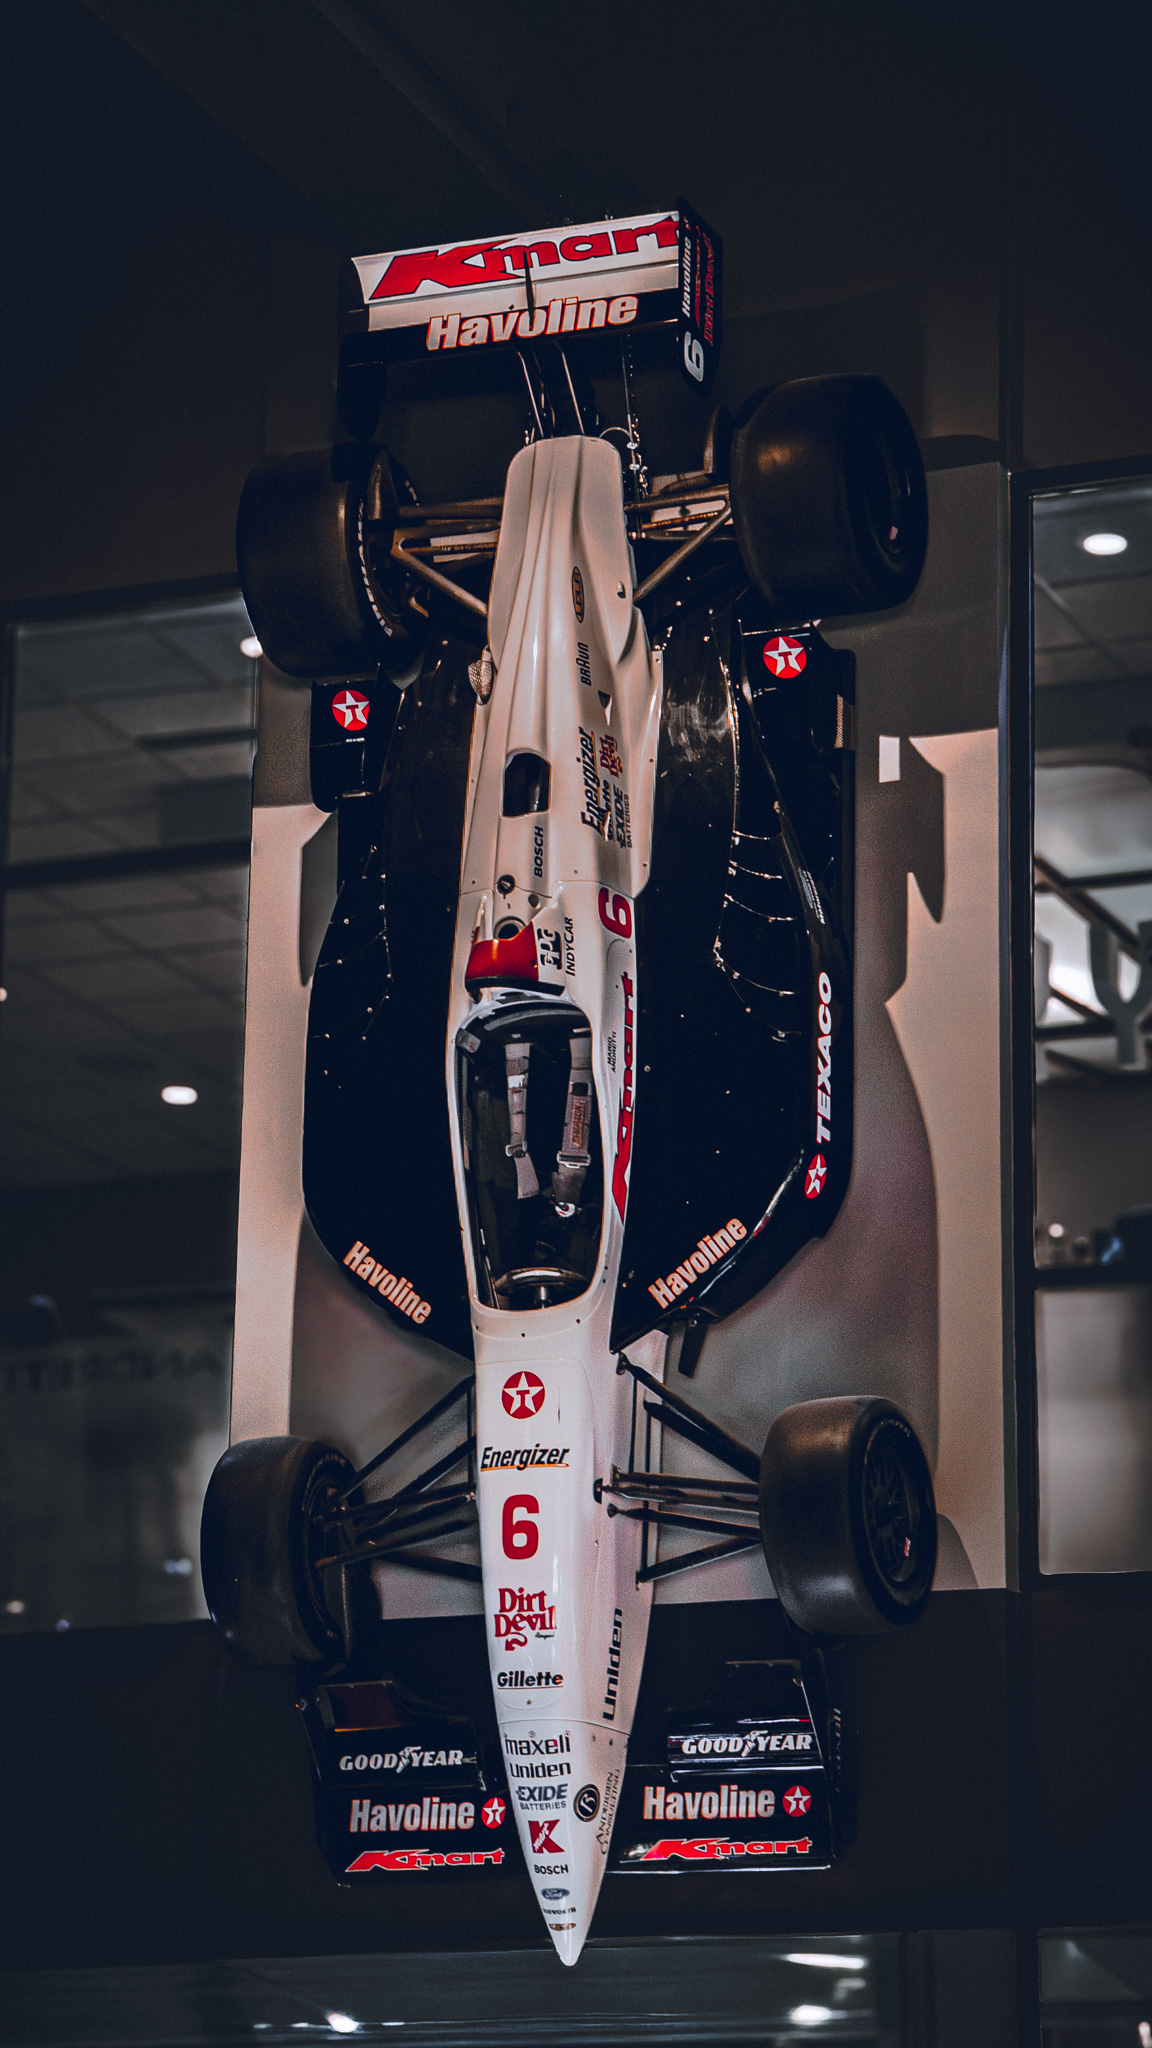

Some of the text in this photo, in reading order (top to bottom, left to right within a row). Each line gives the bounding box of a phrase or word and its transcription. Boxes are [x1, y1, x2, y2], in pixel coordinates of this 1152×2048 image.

[369, 216, 680, 300] Kmart
[682, 236, 692, 318] Havoline
[426, 294, 638, 351] Havoline
[684, 331, 704, 382] 6
[576, 642, 592, 686] BRAUN
[578, 726, 604, 834] Energizer
[612, 783, 626, 849] EXIDE
[623, 794, 633, 848] BATTERIES
[534, 826, 544, 878] BOSCH
[598, 887, 632, 939] 6
[816, 972, 832, 1144] TEXACO
[612, 972, 633, 1226] Kmart
[343, 1240, 431, 1324] Havoline
[648, 1218, 747, 1309] Havoline
[480, 1443, 570, 1472] Energizer
[502, 1494, 539, 1560] 6
[494, 1605, 557, 1637] Devil
[498, 1587, 547, 1613] Dirt
[497, 1670, 563, 1688] Gillette
[505, 1734, 571, 1756] maxell
[350, 1797, 475, 1832] Havoline
[516, 1783, 568, 1802] EXIDE
[520, 1801, 567, 1811] BATTERIES
[643, 1785, 776, 1820] Havoline
[345, 1847, 505, 1872] Kmart
[534, 1864, 569, 1875] BOSCH
[640, 1837, 812, 1861] Kmart
